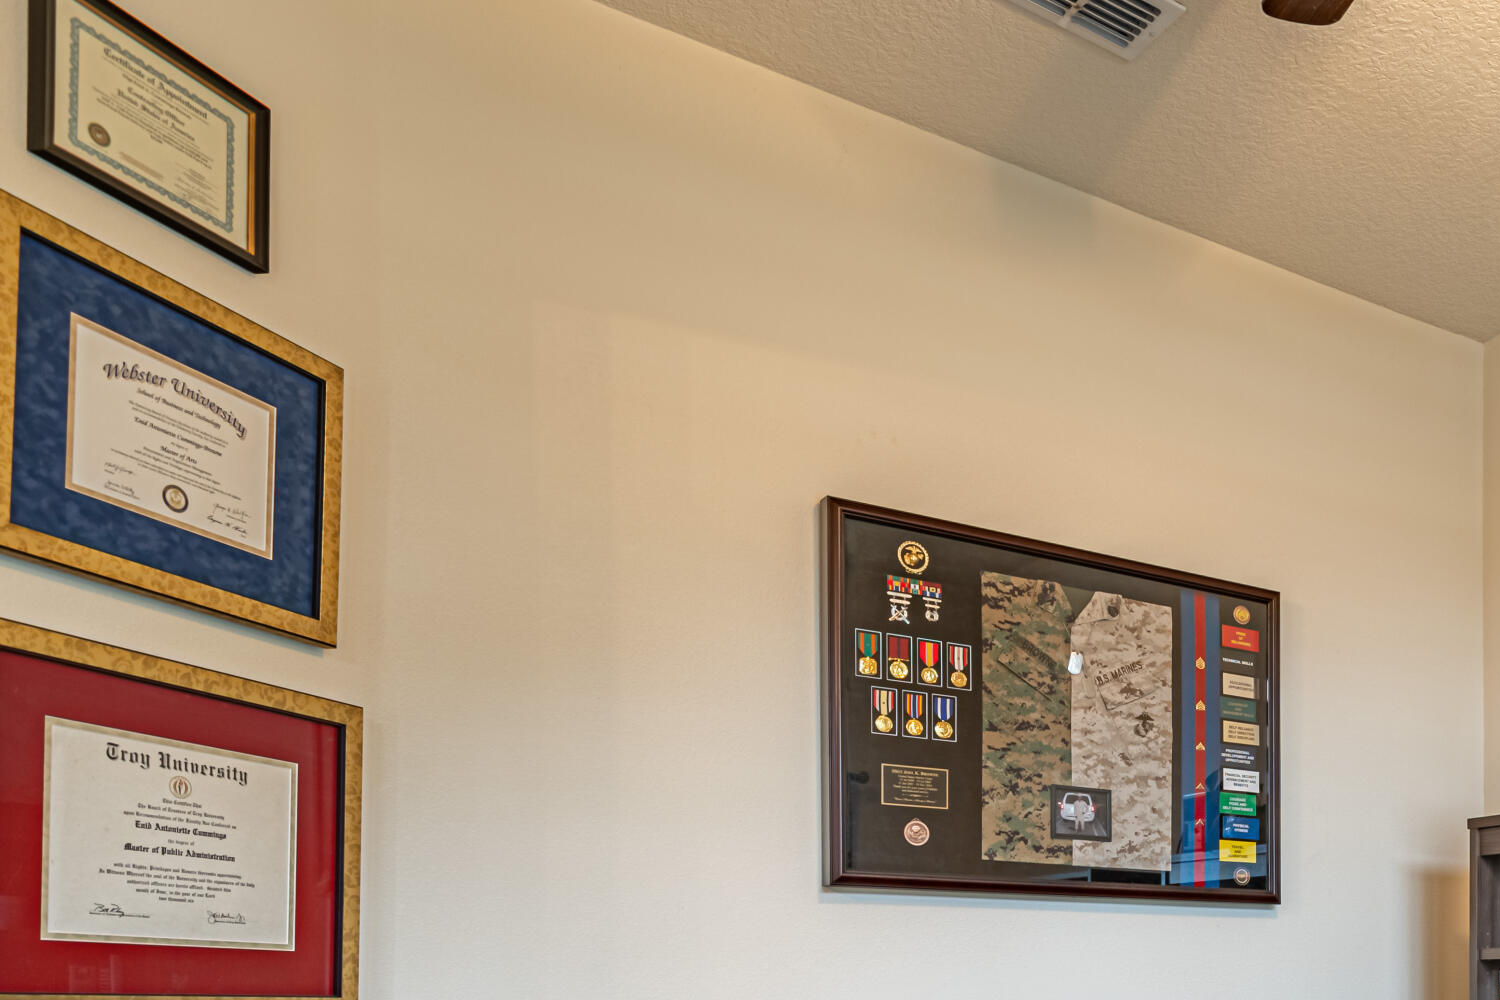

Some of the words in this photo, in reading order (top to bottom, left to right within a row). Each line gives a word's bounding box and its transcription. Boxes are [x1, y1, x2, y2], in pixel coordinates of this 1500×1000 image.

[103, 361, 167, 387] Webster
[171, 378, 248, 440] University
[160, 445, 179, 457] Master
[187, 456, 198, 464] Arts
[1110, 661, 1143, 680] MARINES
[106, 742, 150, 769] Troy
[158, 751, 248, 787] University
[135, 820, 152, 830] Enid
[124, 842, 149, 853] Master
[152, 846, 159, 854] of
[161, 846, 183, 857] Public
[185, 849, 236, 862] Administration
